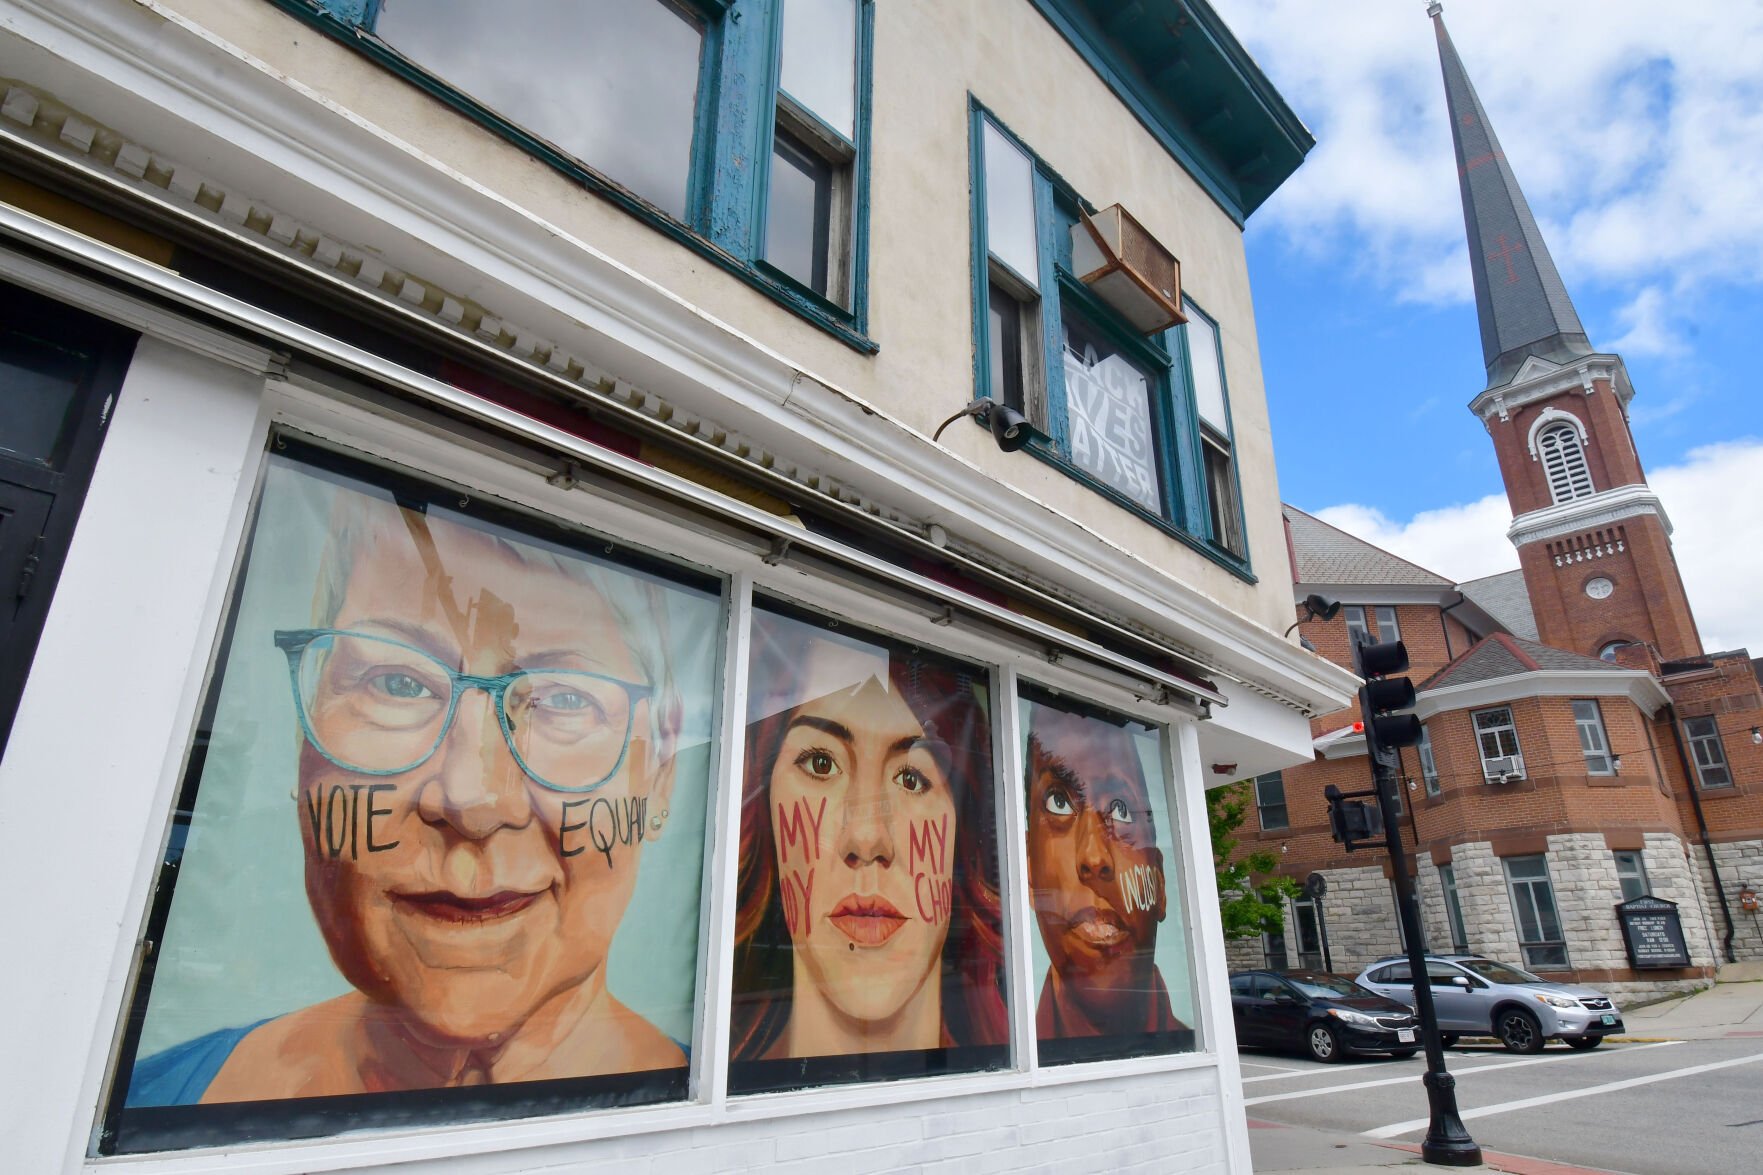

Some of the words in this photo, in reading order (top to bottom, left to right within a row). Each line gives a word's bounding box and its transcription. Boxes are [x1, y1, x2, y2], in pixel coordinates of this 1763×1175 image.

[306, 782, 400, 860] VOTE
[778, 796, 827, 864] MY
[909, 813, 948, 876] MY
